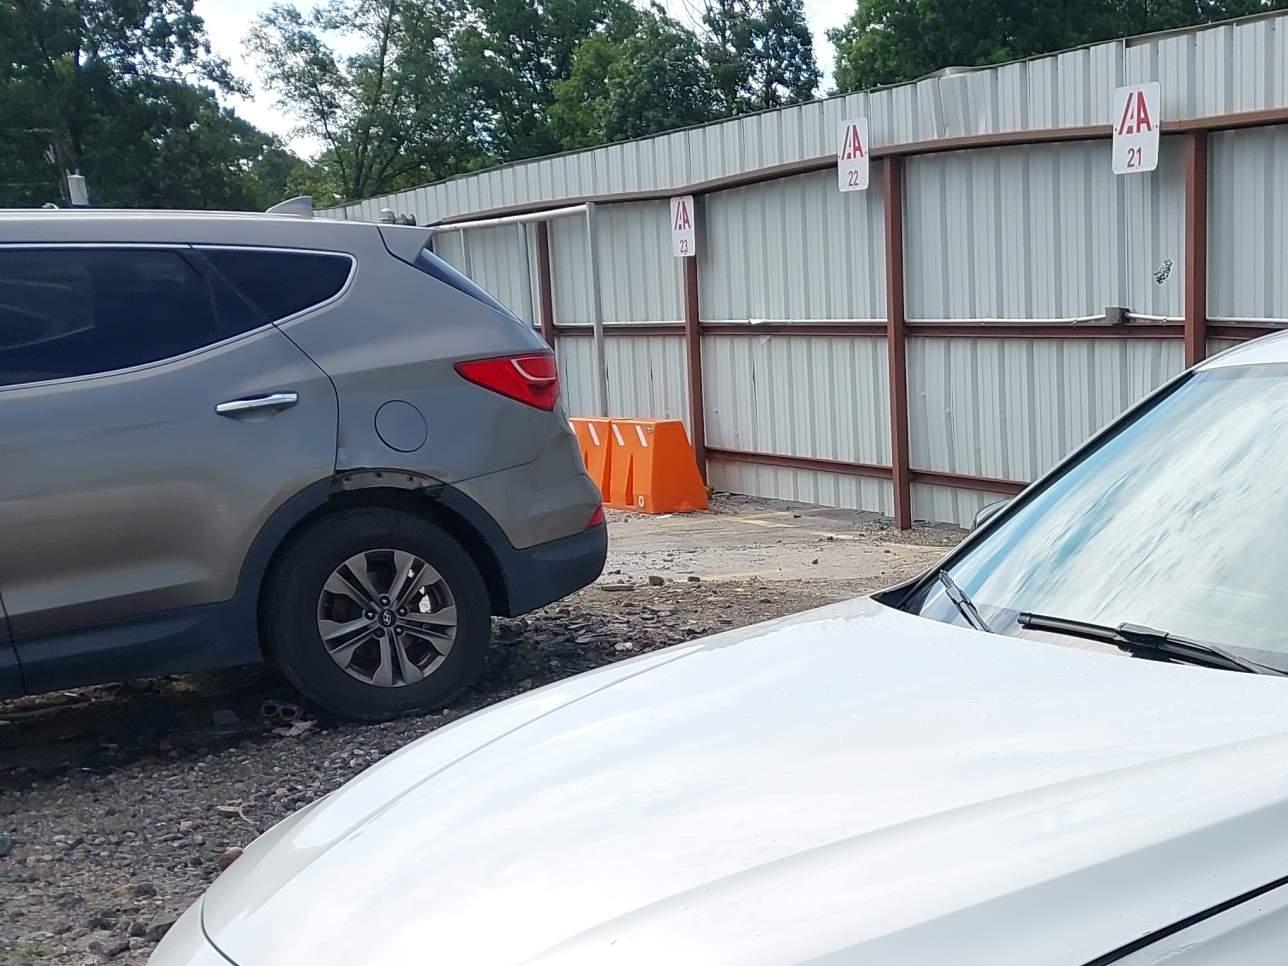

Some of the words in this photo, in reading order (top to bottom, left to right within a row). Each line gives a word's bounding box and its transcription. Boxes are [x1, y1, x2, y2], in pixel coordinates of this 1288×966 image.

[1127, 147, 1142, 169] 21
[847, 169, 860, 187] 22
[680, 239, 688, 253] 23
